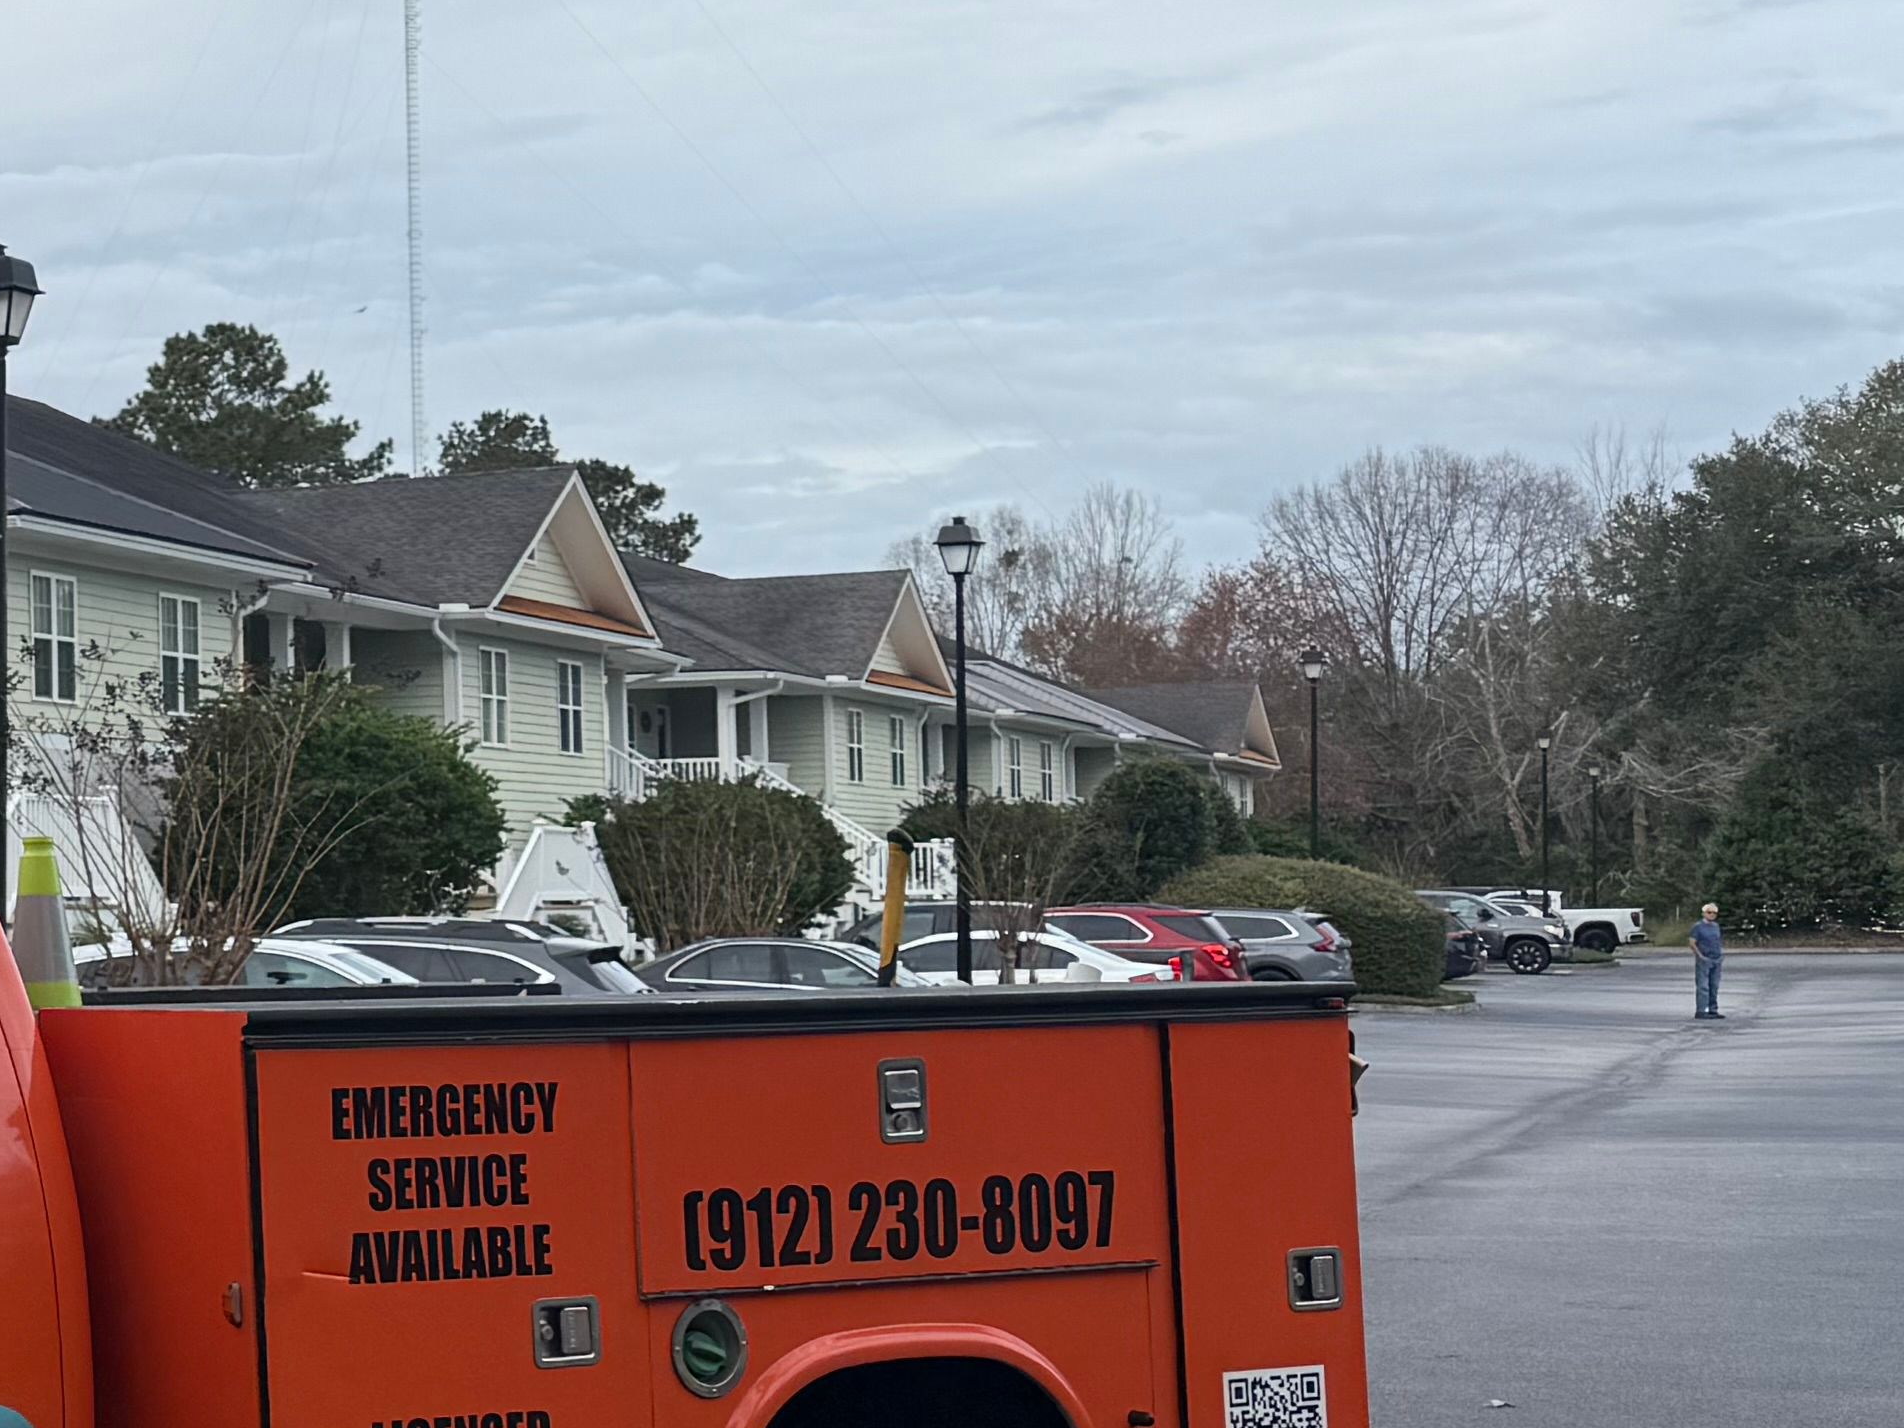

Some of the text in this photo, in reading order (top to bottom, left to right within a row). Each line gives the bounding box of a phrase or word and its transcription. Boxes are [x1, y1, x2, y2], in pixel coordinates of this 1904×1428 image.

[330, 1081, 559, 1141] EMERGENCY
[367, 1153, 530, 1212] SERVICE
[682, 1170, 1116, 1272] (912) 230-8097
[348, 1224, 554, 1285] AVAILABLE
